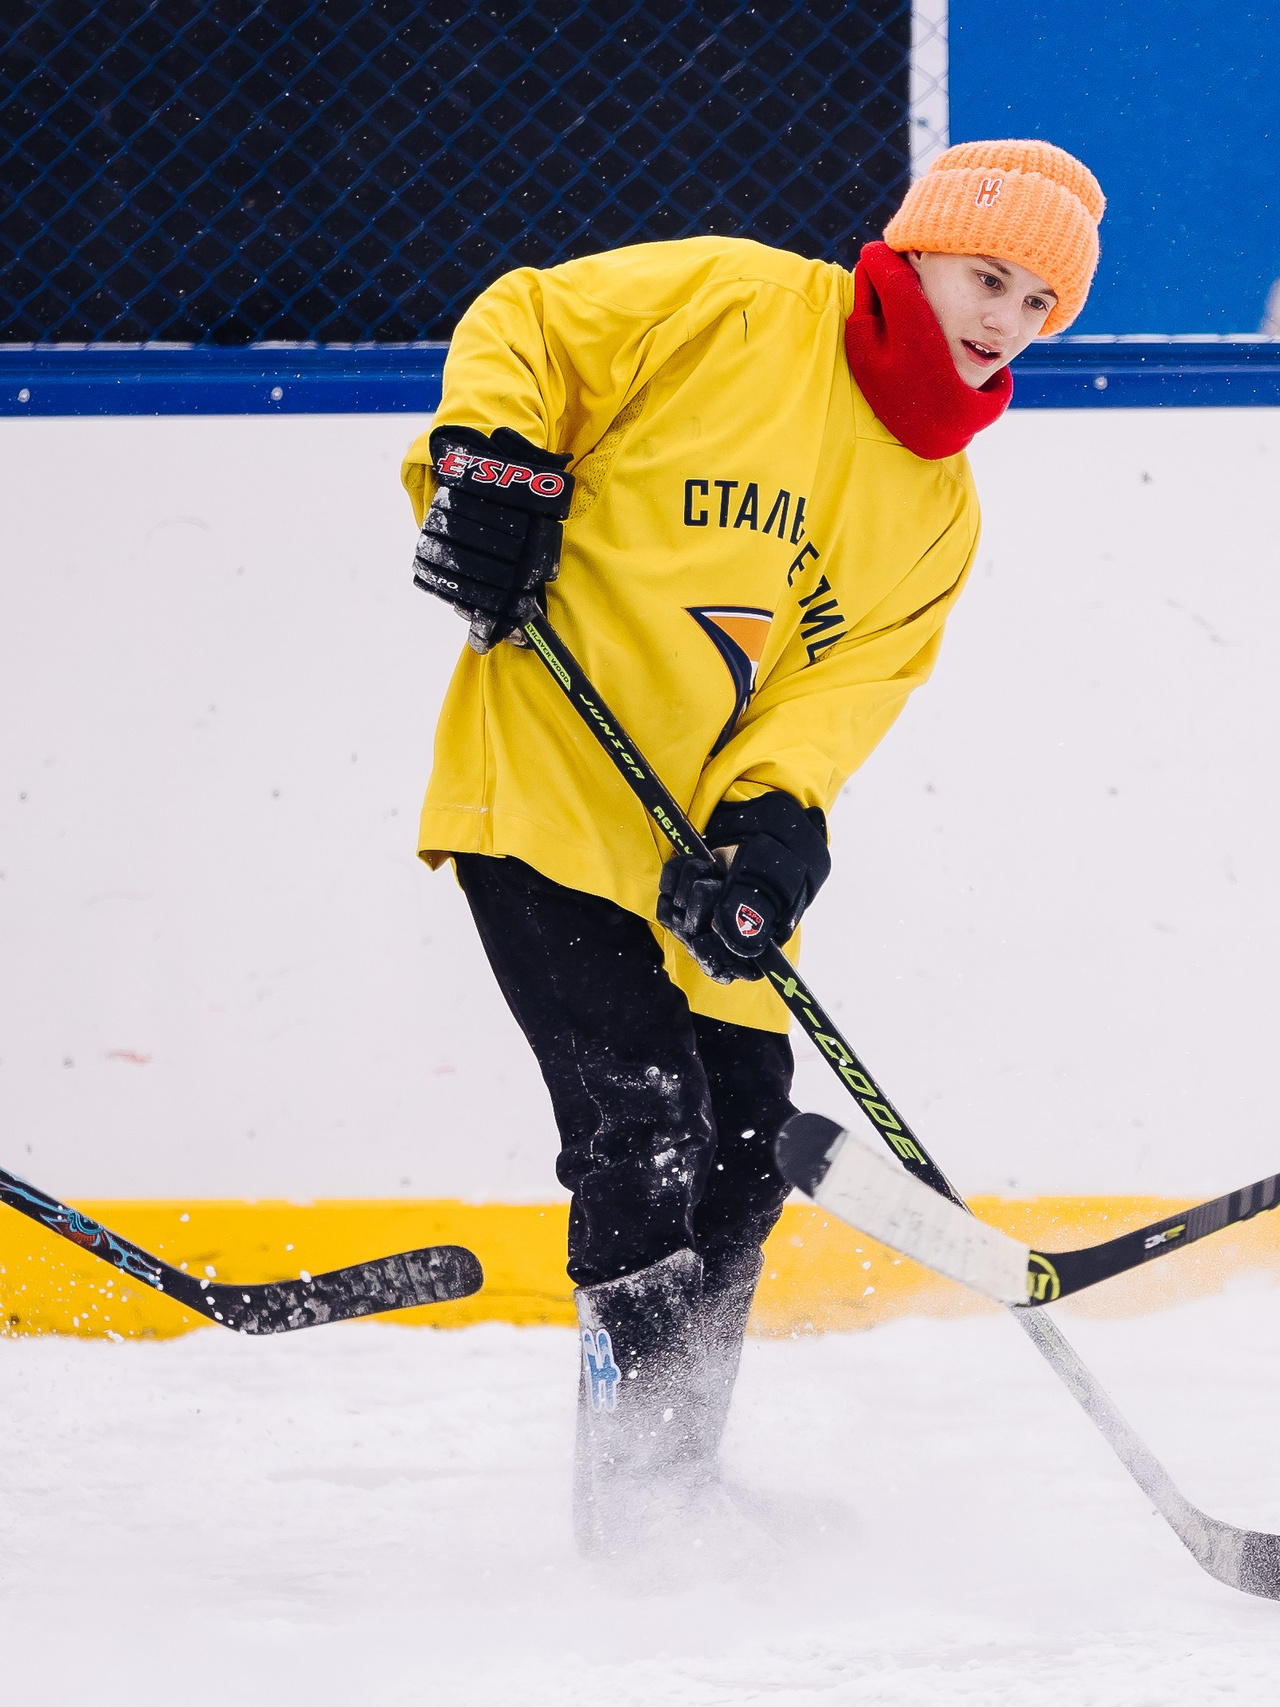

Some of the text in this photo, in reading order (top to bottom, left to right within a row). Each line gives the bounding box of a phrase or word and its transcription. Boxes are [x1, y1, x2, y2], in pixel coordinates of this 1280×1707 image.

[550, 657, 570, 684] WOOD
[579, 693, 645, 780] JUNIOR
[769, 970, 927, 1165] X-CODE
